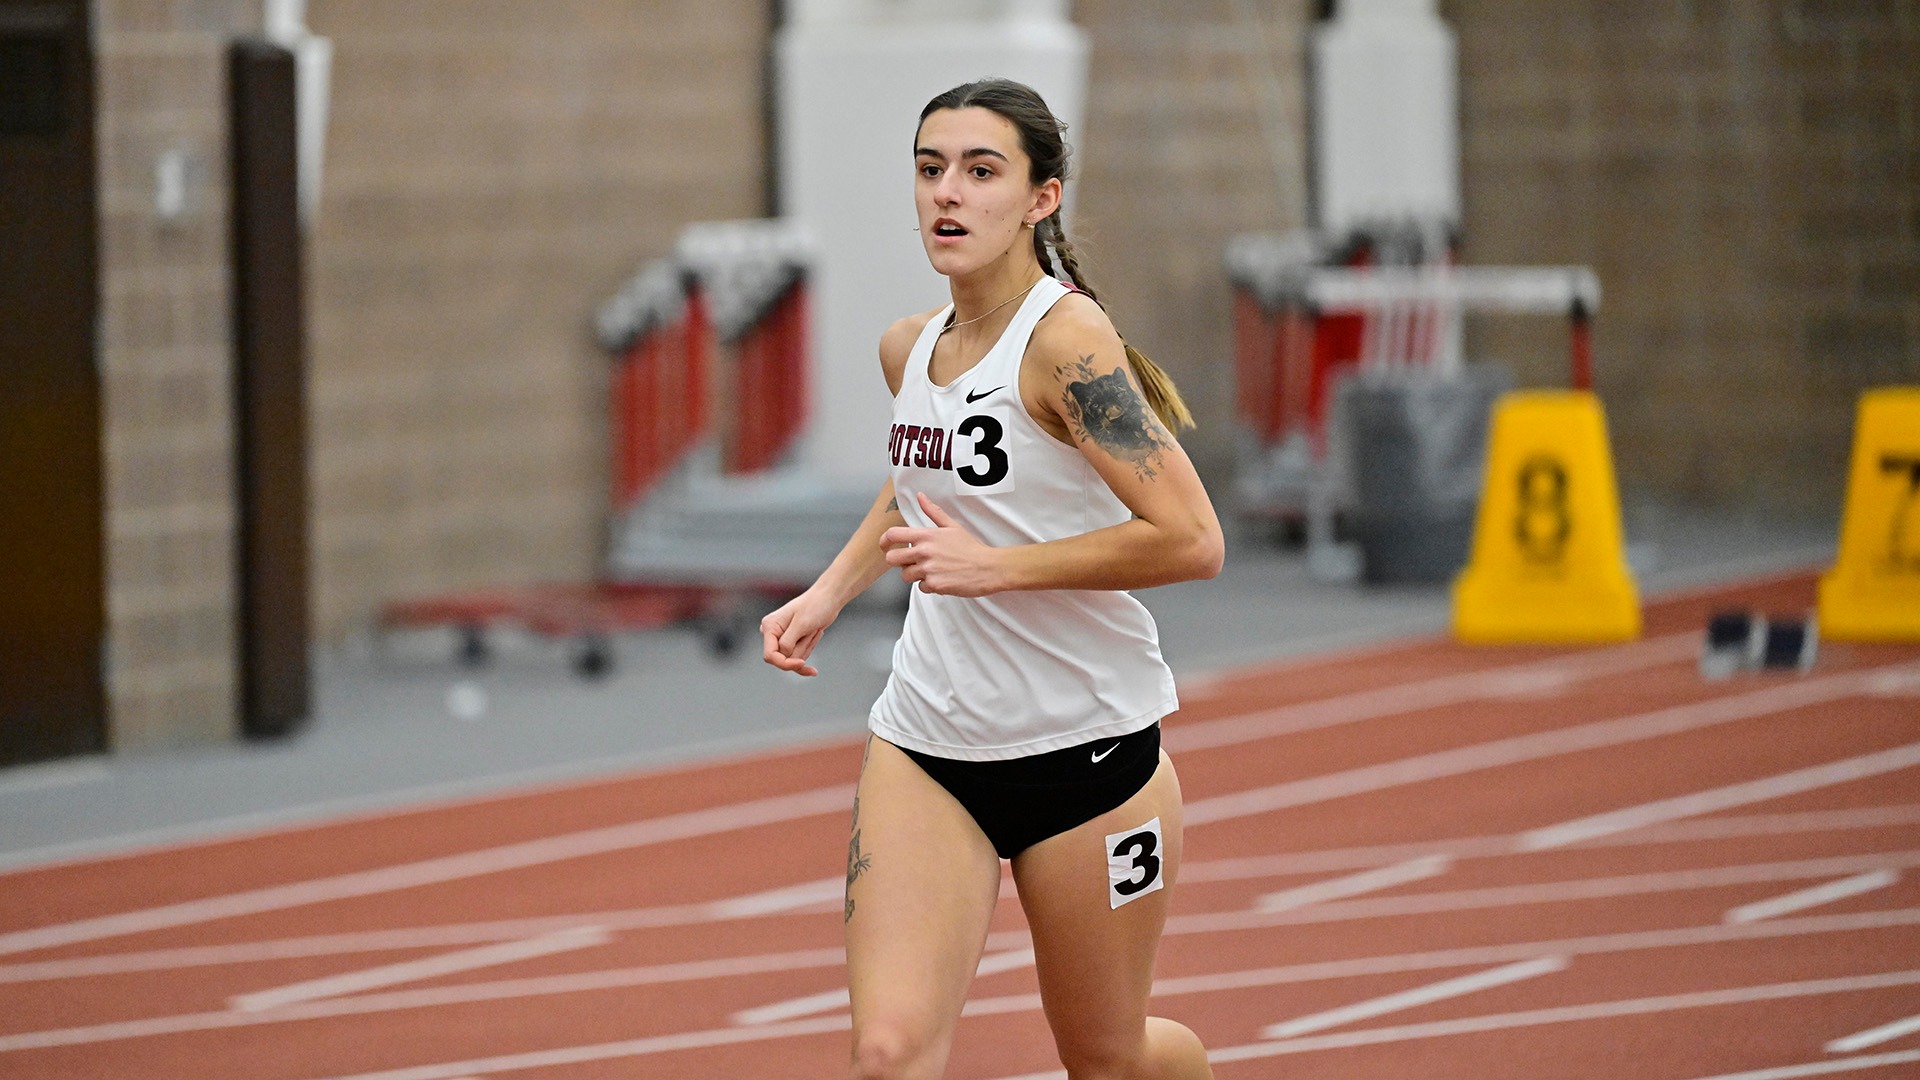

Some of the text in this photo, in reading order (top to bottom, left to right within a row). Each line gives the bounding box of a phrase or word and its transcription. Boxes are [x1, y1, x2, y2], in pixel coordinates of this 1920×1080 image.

[956, 414, 1009, 487] 3
[1516, 455, 1571, 565] 8
[1112, 830, 1160, 896] 3
